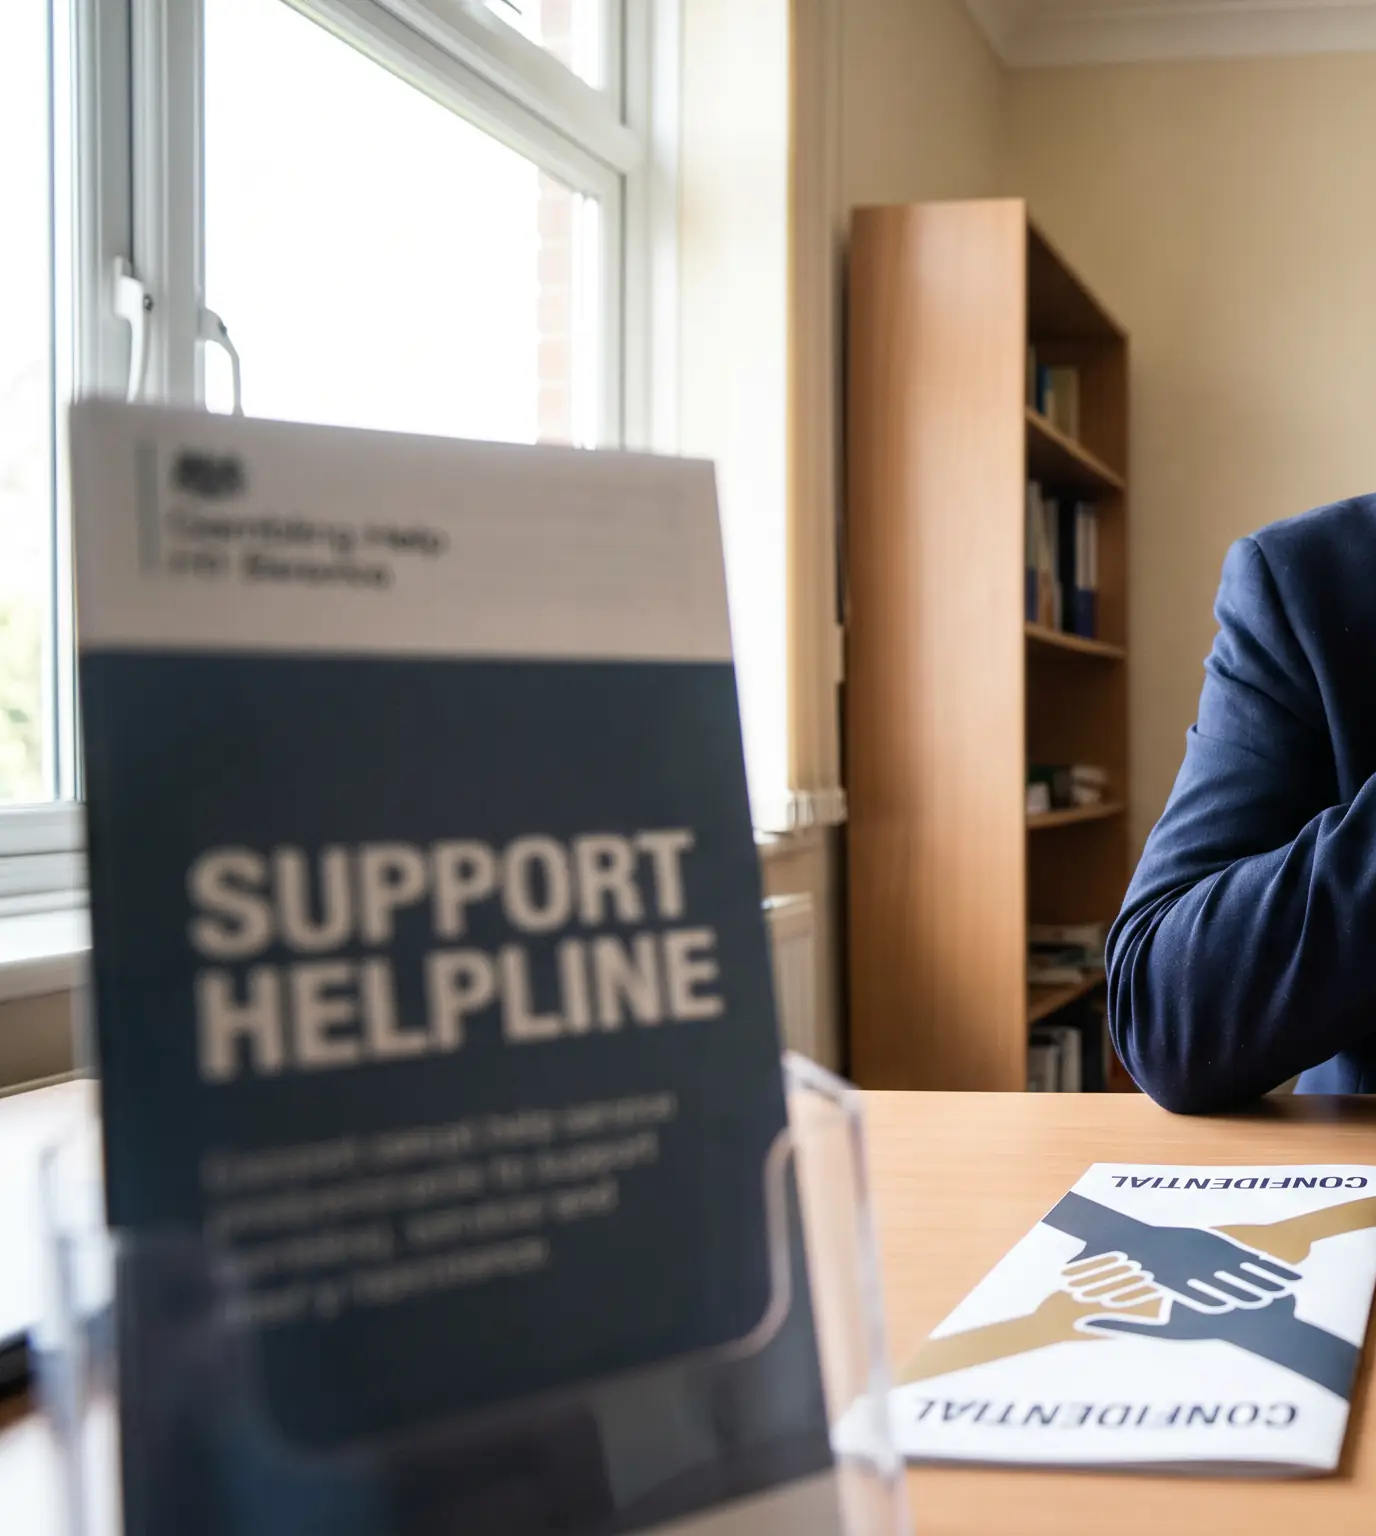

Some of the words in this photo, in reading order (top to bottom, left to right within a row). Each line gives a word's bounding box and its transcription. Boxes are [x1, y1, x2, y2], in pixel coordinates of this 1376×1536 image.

[188, 829, 694, 960] SUPPORT
[196, 926, 725, 1083] HELPLINE
[1110, 1174, 1369, 1190] CONFIDENTIAL
[915, 1397, 1298, 1430] CONFIDENTIAL
